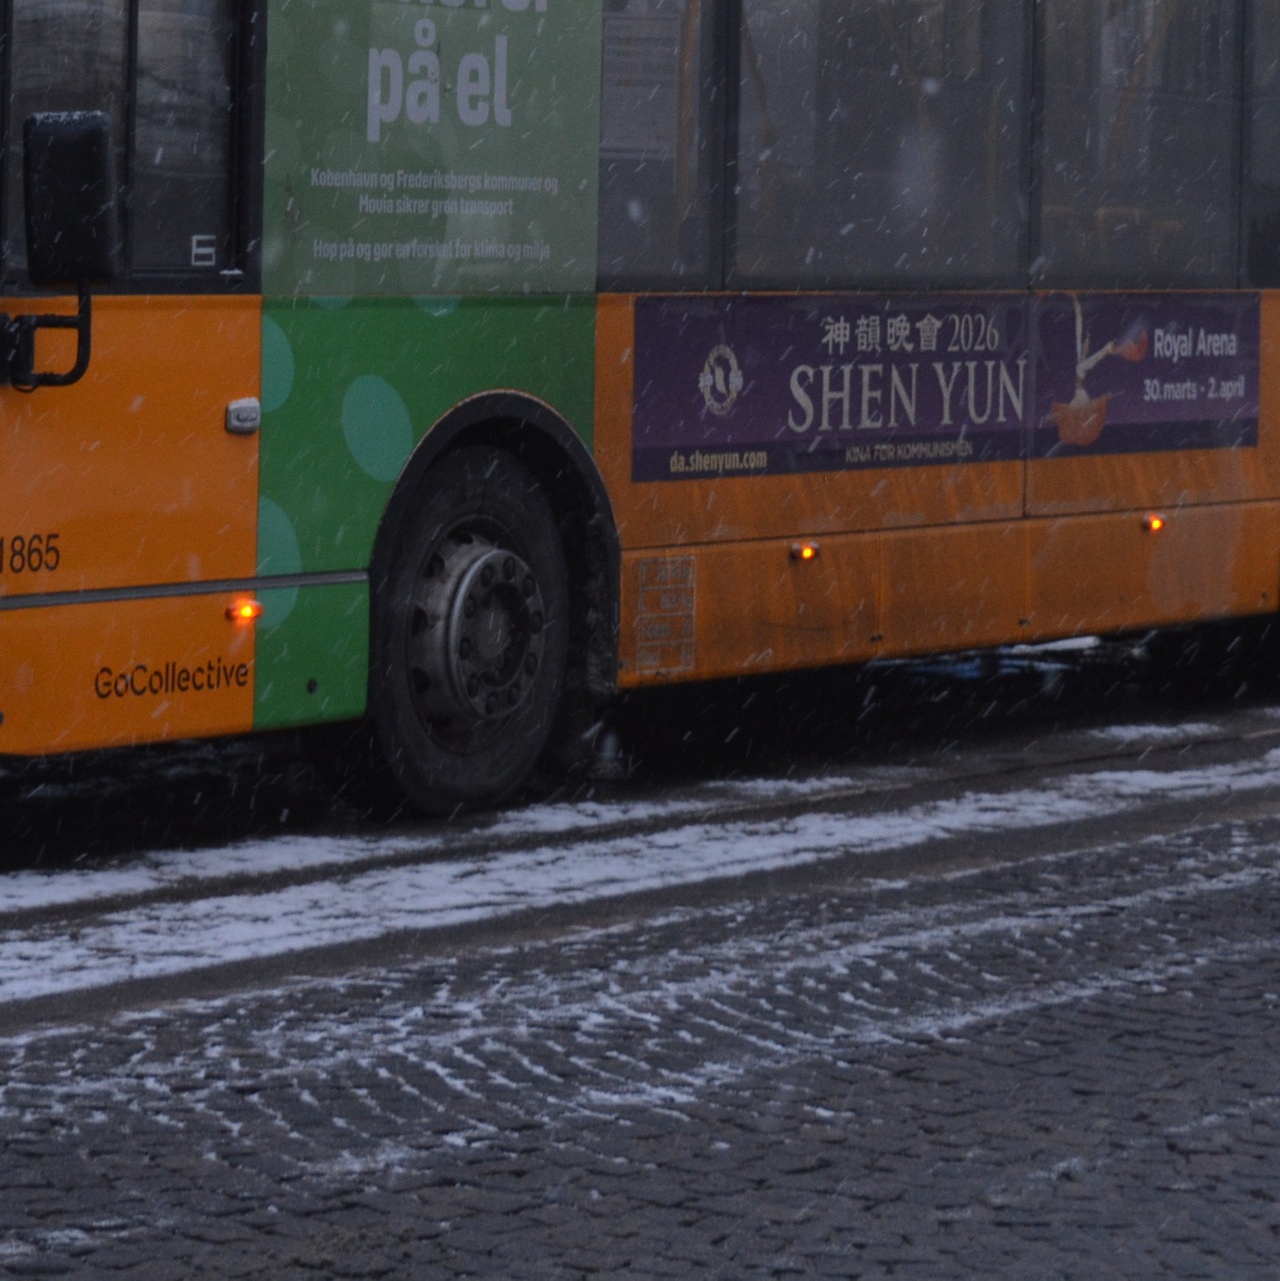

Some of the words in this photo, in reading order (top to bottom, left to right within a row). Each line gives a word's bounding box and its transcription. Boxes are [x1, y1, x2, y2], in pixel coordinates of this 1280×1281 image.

[367, 19, 441, 142] på
[456, 35, 512, 127] el
[396, 169, 482, 193] Frederiksbergs
[484, 172, 542, 191] kommuner
[544, 177, 559, 196] og
[359, 193, 394, 213] Movia
[395, 194, 430, 213] sikrer
[460, 197, 513, 218] transport
[313, 237, 338, 261] Hop
[339, 237, 355, 261] på
[356, 243, 371, 262] og
[474, 238, 505, 259] klima
[946, 314, 999, 352] 2026
[1153, 326, 1193, 364] Royal
[1195, 327, 1238, 357] Arena
[788, 362, 918, 434] SHEN
[932, 359, 1028, 425] YUN
[669, 449, 768, 473] da.shenyun.com
[94, 657, 249, 698] GoCollective
